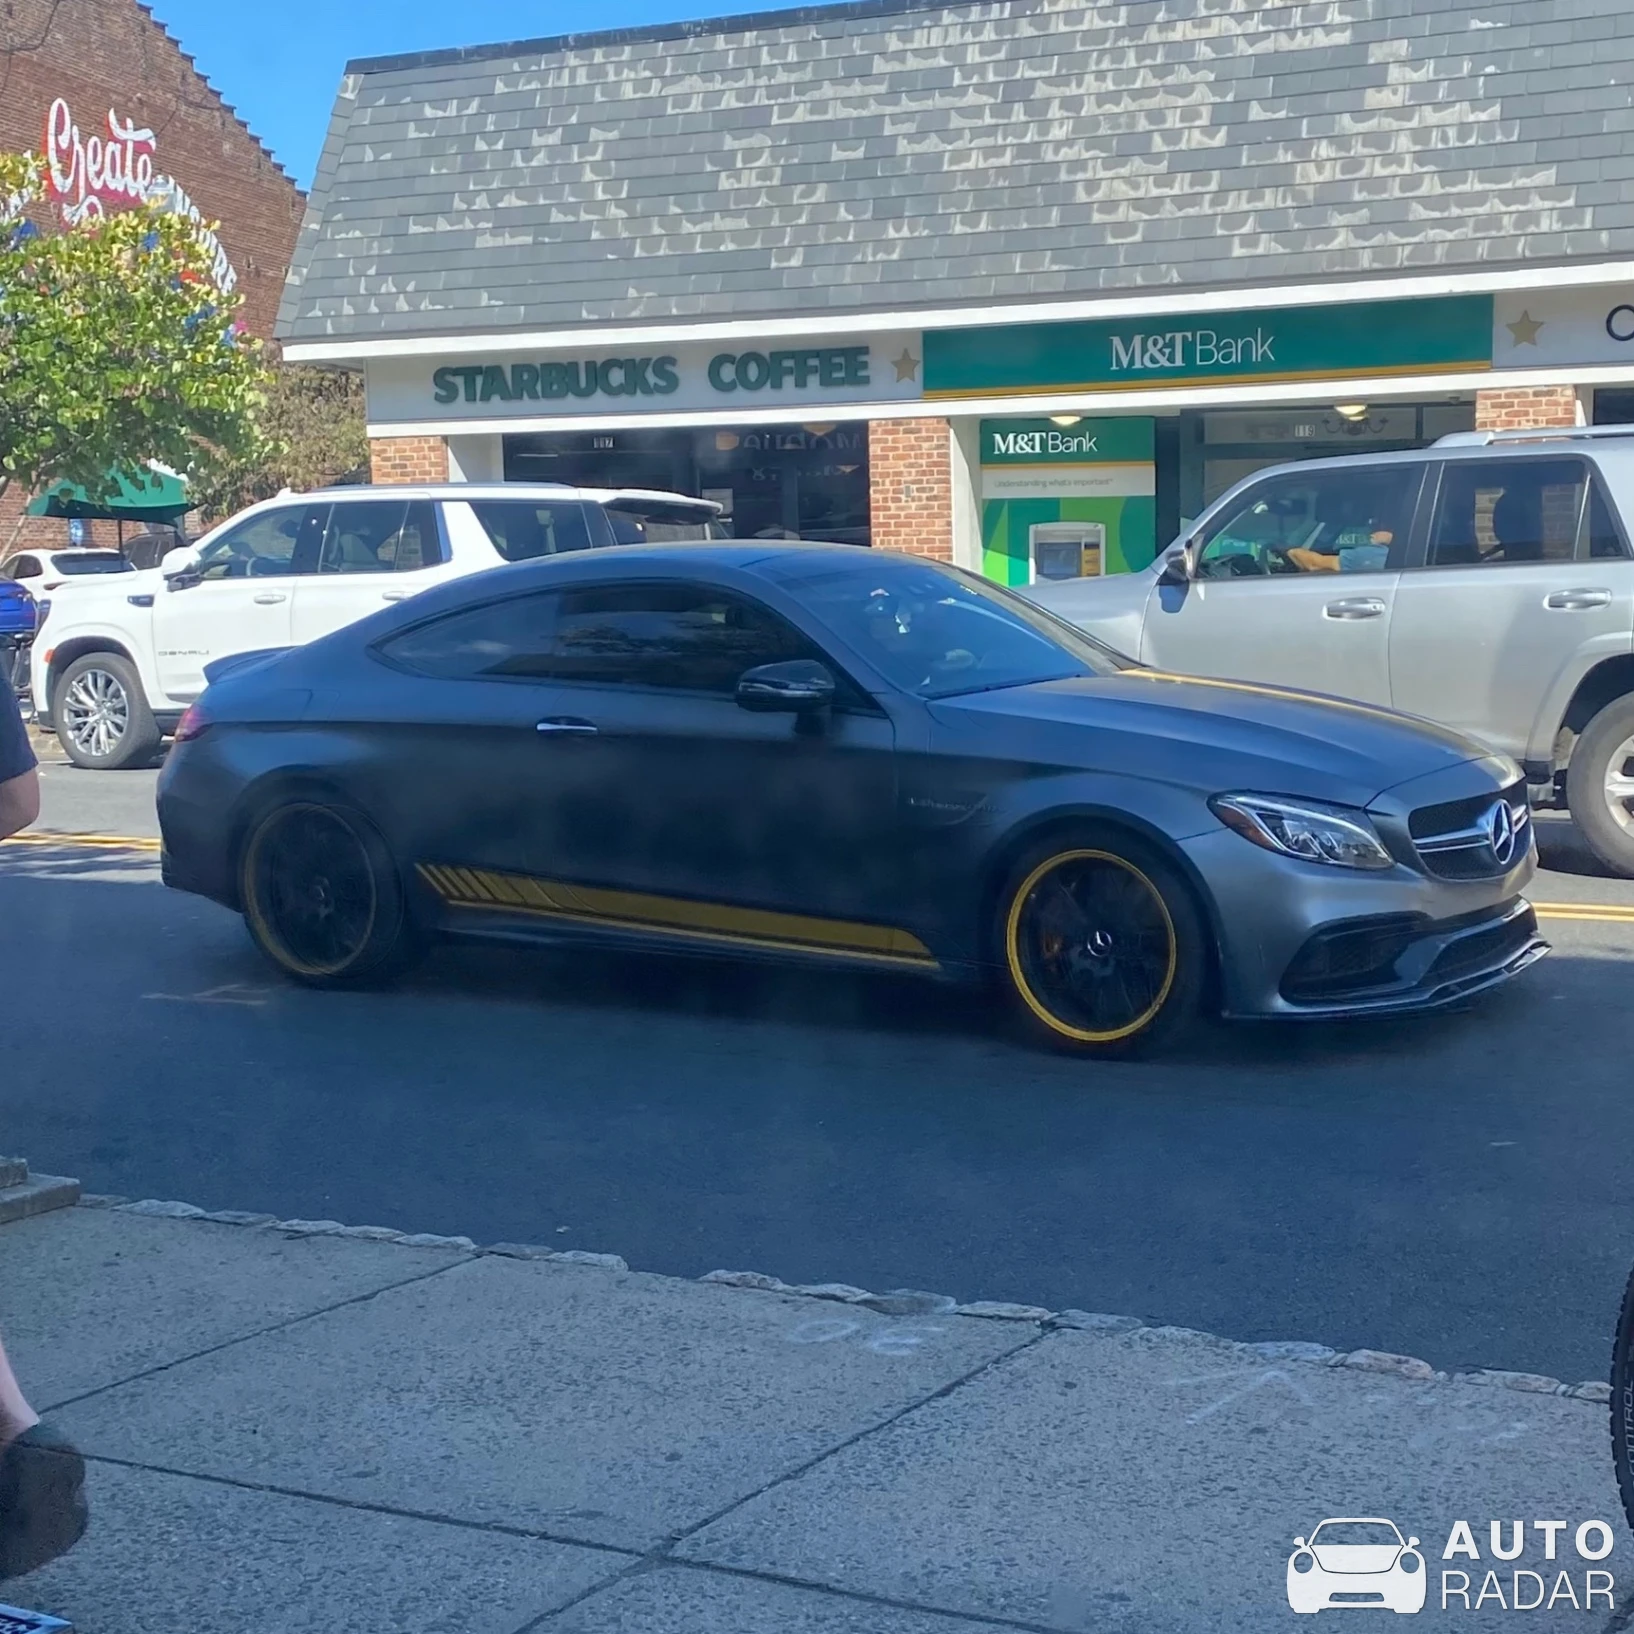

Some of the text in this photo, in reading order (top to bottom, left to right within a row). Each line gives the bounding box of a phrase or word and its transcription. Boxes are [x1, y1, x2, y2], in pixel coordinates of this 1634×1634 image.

[47, 97, 156, 227] Create
[1109, 327, 1275, 370] M&T Bank
[433, 346, 870, 404] STARBUCKS COFFEE
[993, 431, 1098, 454] M&T Bank
[1295, 425, 1315, 437] 119
[994, 479, 1047, 489] Understanding
